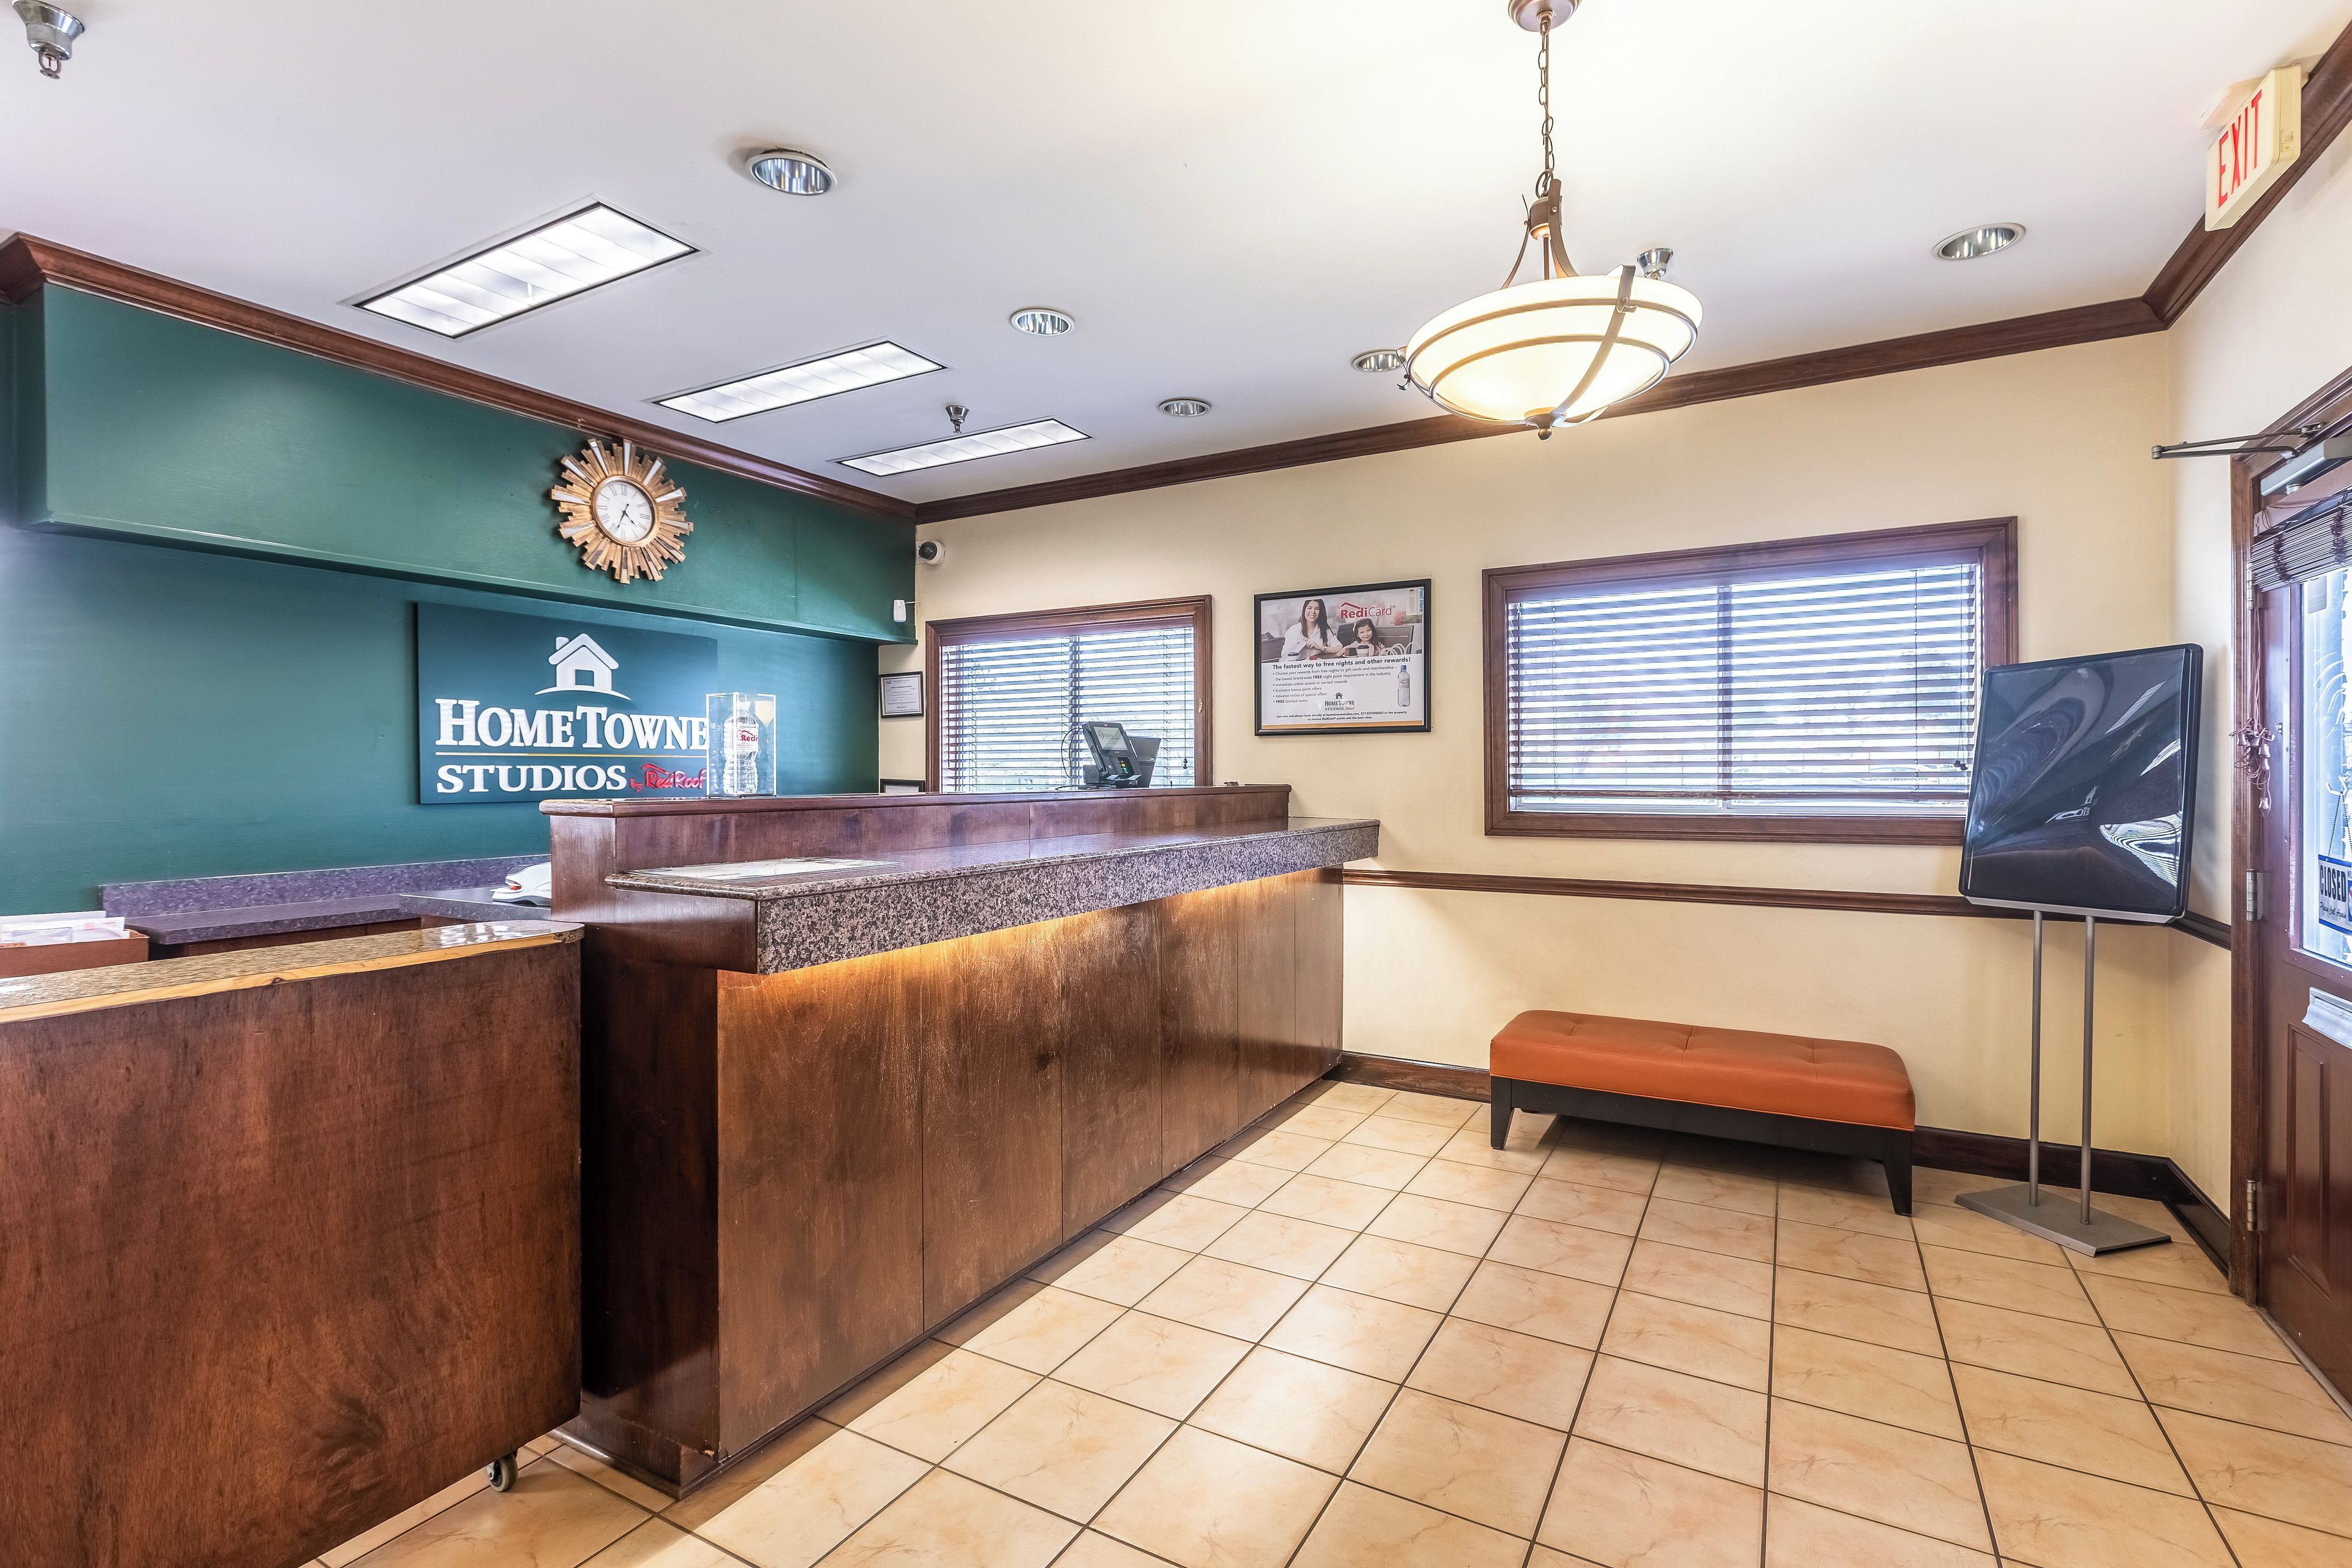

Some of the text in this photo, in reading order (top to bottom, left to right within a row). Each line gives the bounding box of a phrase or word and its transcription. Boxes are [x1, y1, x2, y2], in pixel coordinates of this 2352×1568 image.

[2218, 89, 2262, 209] EXIT
[437, 765, 627, 793] STUDIOS
[630, 778, 643, 792] by
[2320, 865, 2346, 902] CLOSED
